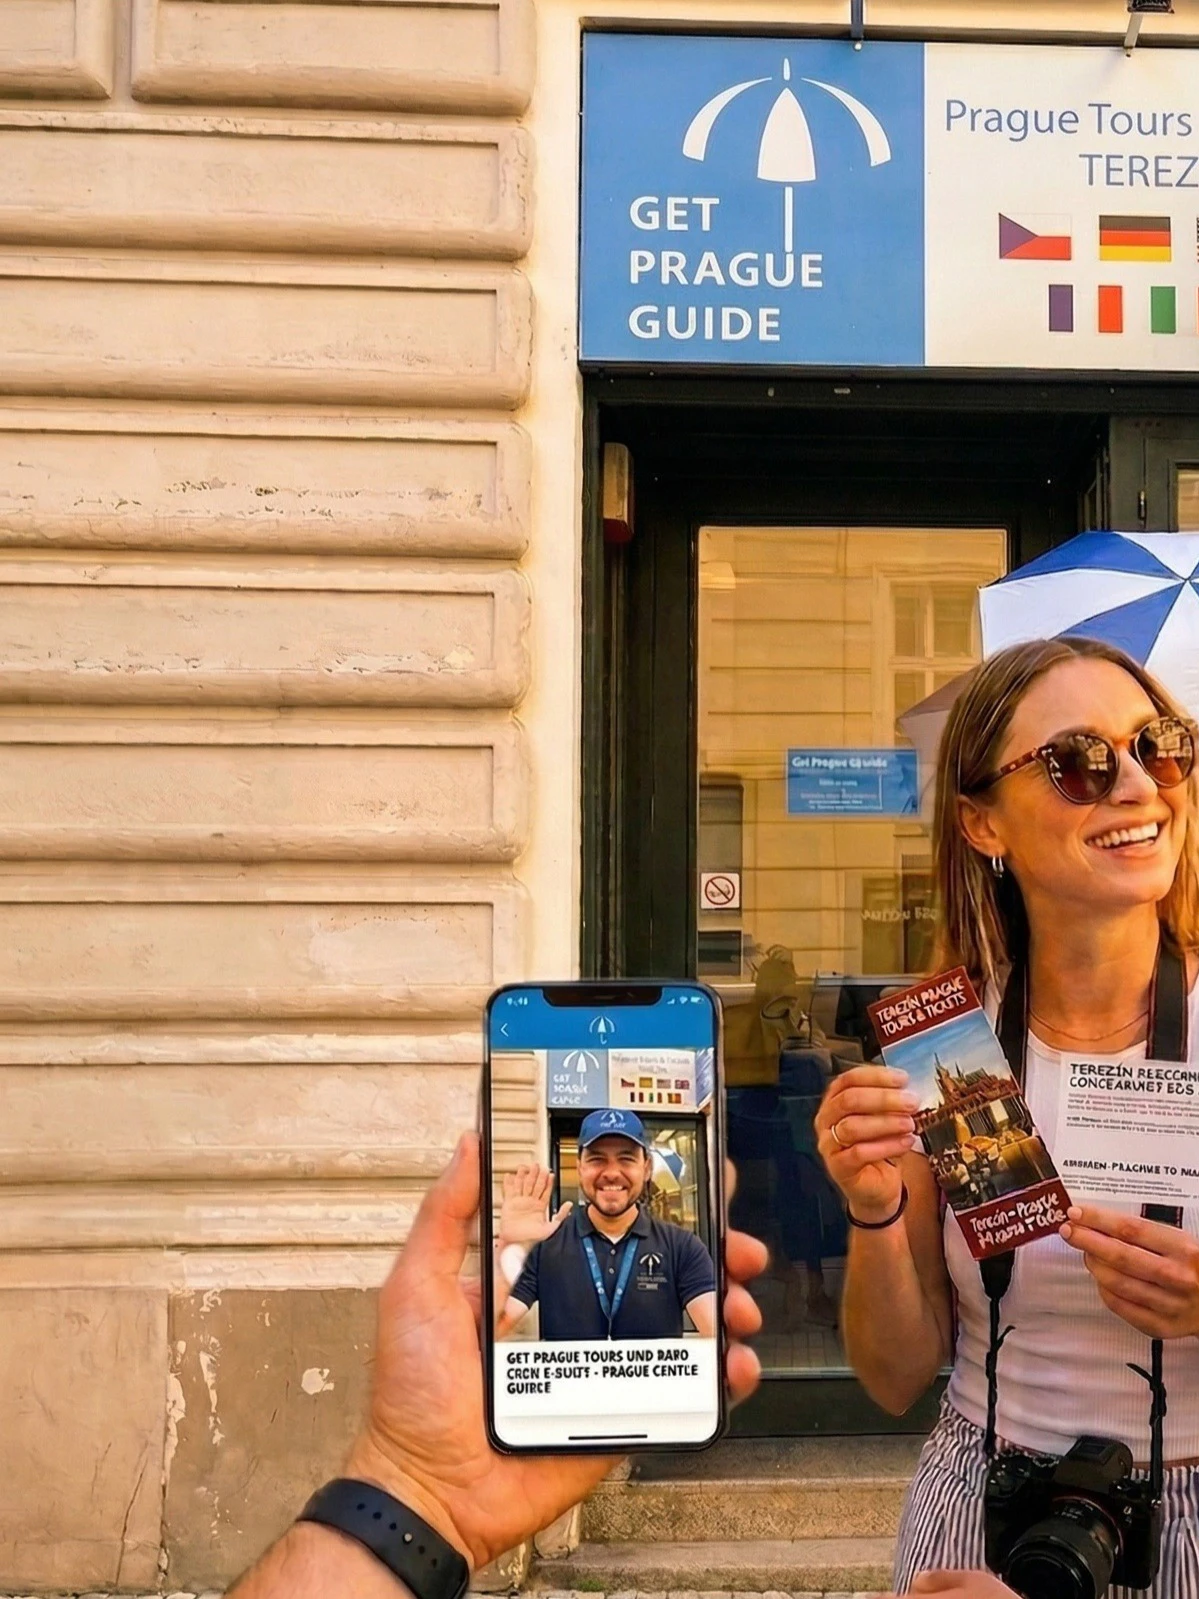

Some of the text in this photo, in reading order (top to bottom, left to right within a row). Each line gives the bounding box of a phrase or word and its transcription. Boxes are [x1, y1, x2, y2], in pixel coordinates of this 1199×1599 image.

[945, 99, 1079, 142] Prague
[1088, 102, 1192, 137] Tours
[628, 195, 720, 232] GET
[629, 250, 824, 289] PRAGUE
[628, 304, 781, 342] GUIDE
[507, 1351, 530, 1364] GET
[533, 1351, 580, 1364] PRAGUE
[583, 1350, 623, 1363] TOURS
[626, 1349, 654, 1362] UND
[602, 1365, 650, 1378] PRAGUE
